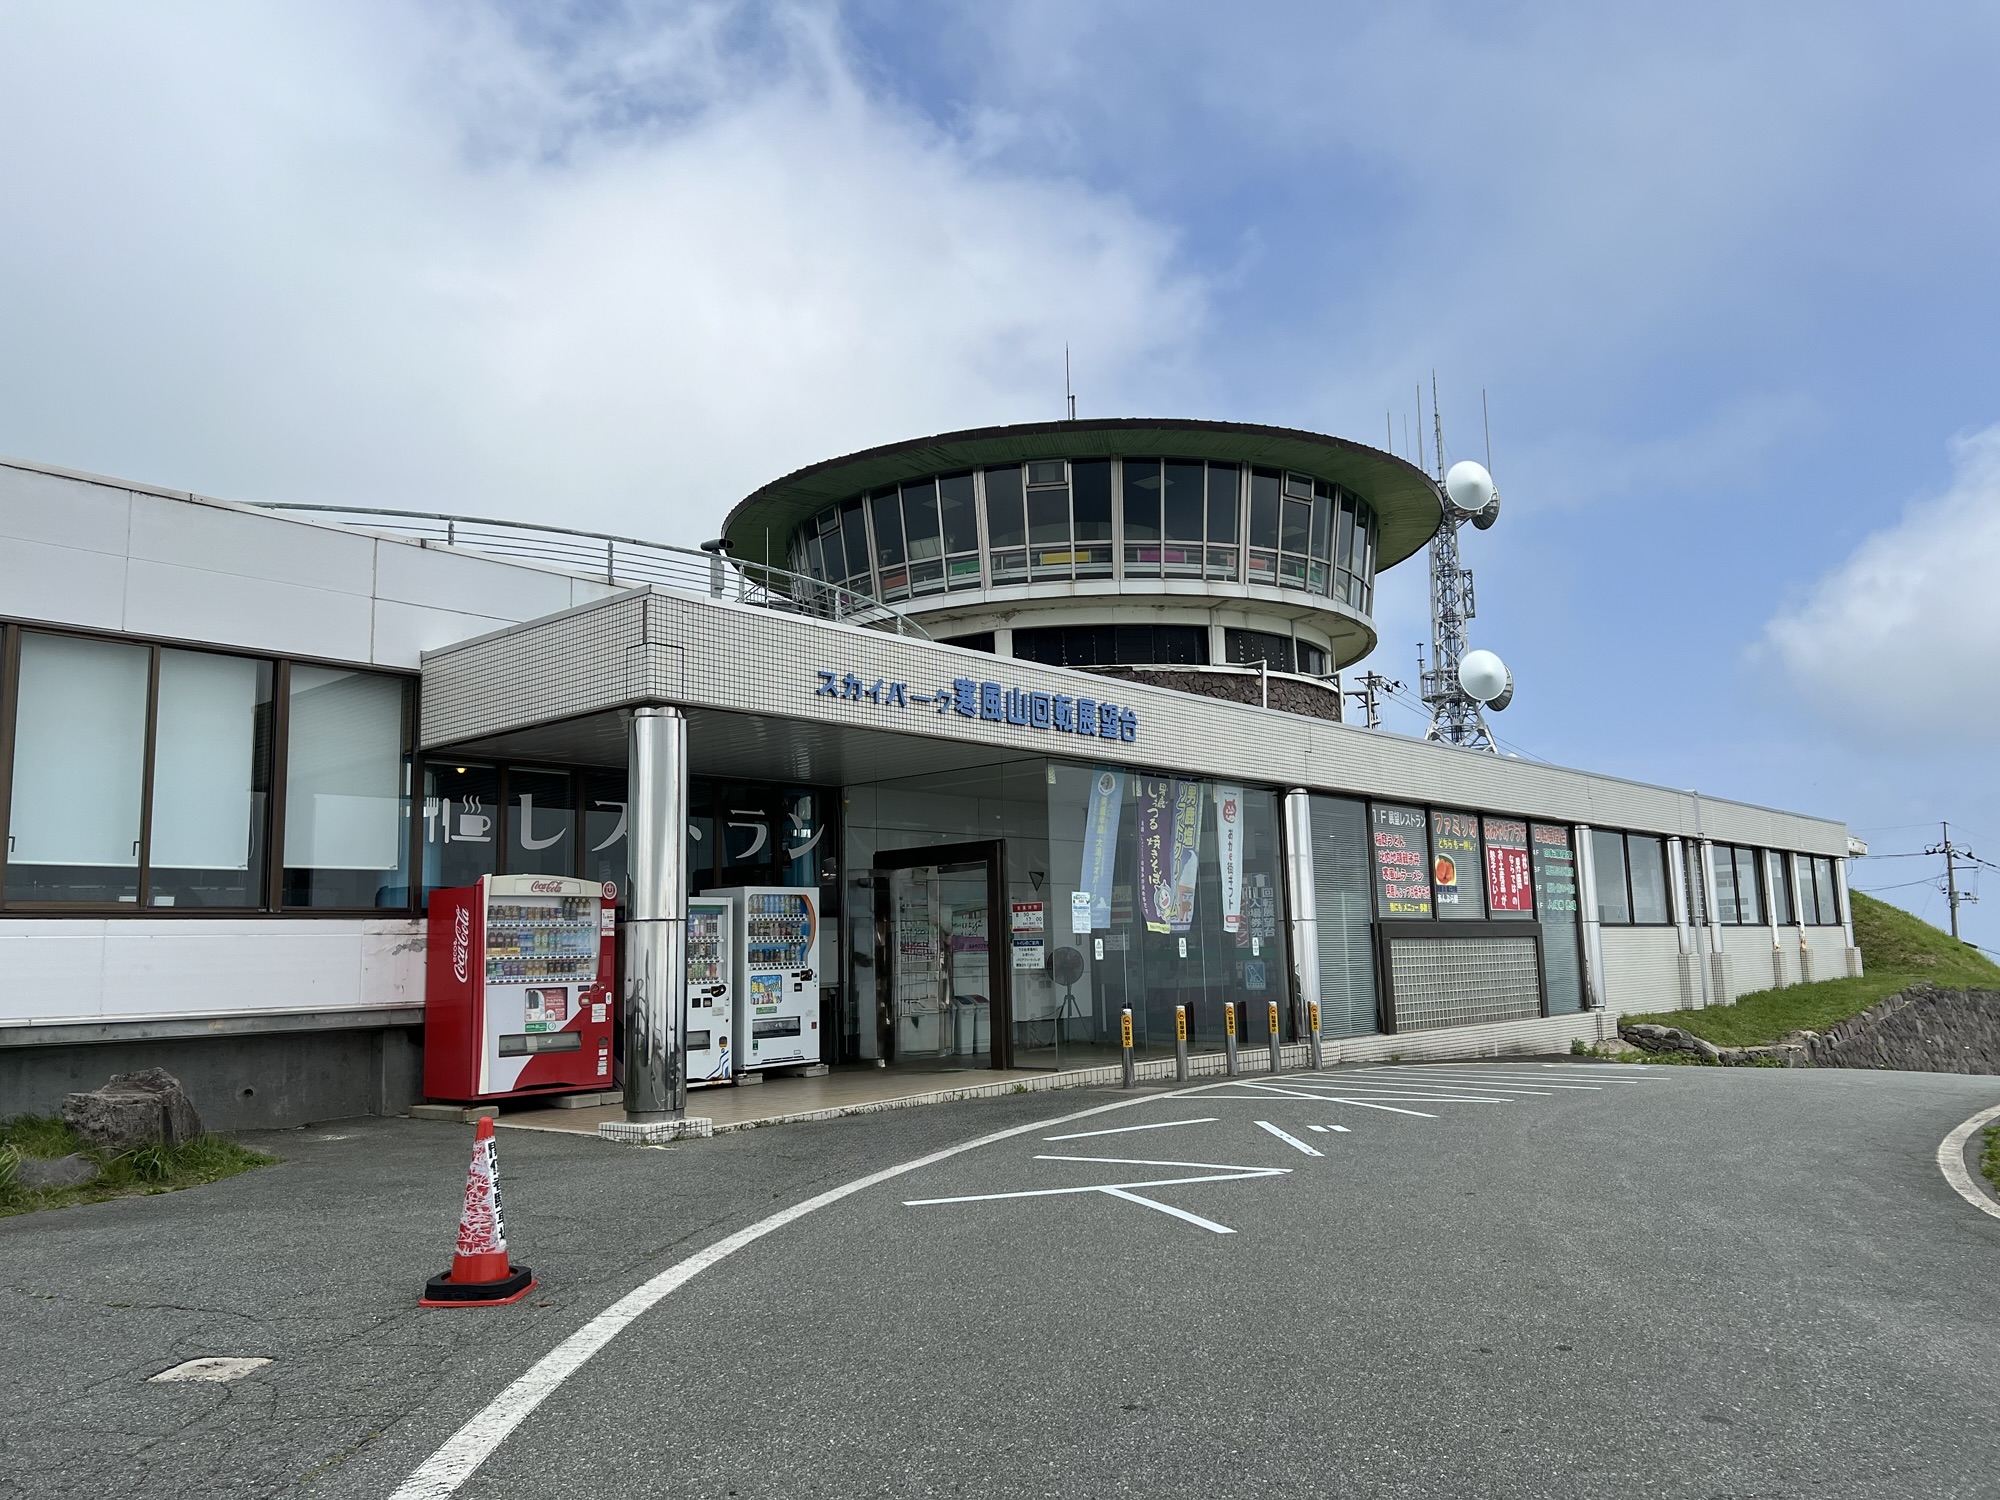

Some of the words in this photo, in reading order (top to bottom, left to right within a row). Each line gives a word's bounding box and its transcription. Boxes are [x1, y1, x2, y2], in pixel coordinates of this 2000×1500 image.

[518, 793, 826, 860] レスラン
[1434, 812, 1477, 838] ファミリオ
[1535, 825, 1567, 846] 回転展望台
[1382, 866, 1424, 882] 寒風山ラーメン
[1508, 854, 1518, 905] ならではの
[1262, 887, 1275, 937] 回転展望台
